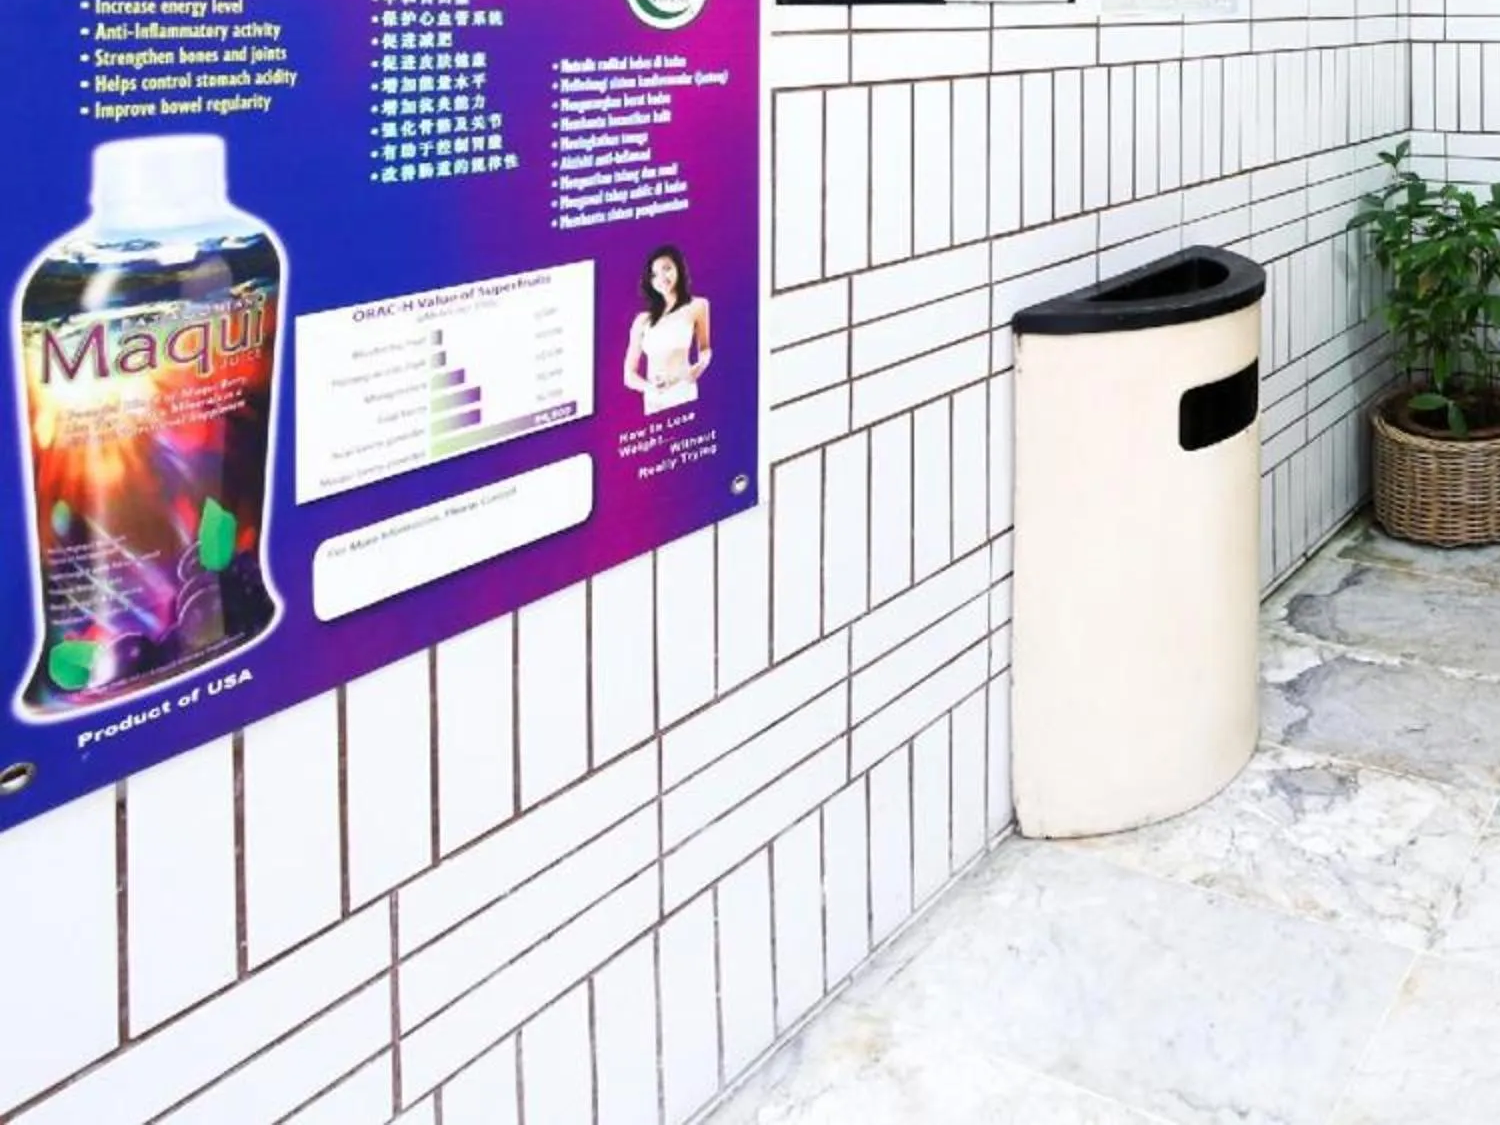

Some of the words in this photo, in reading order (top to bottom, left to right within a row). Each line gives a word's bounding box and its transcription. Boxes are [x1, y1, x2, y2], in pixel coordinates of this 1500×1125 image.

[160, 1, 208, 18] energy
[232, 22, 281, 41] activity
[94, 48, 174, 69] Strengthen
[179, 47, 219, 64] bones
[223, 46, 247, 62] and
[251, 46, 288, 65] joints
[94, 75, 137, 95] Helps
[141, 73, 192, 90] control
[196, 70, 251, 88] stomach
[94, 102, 156, 122] Improve
[160, 96, 203, 114] bowel
[206, 94, 272, 115] regularity
[41, 290, 267, 384] Maqui
[77, 700, 172, 748] Product
[177, 688, 201, 707] of
[207, 668, 253, 696] USA
